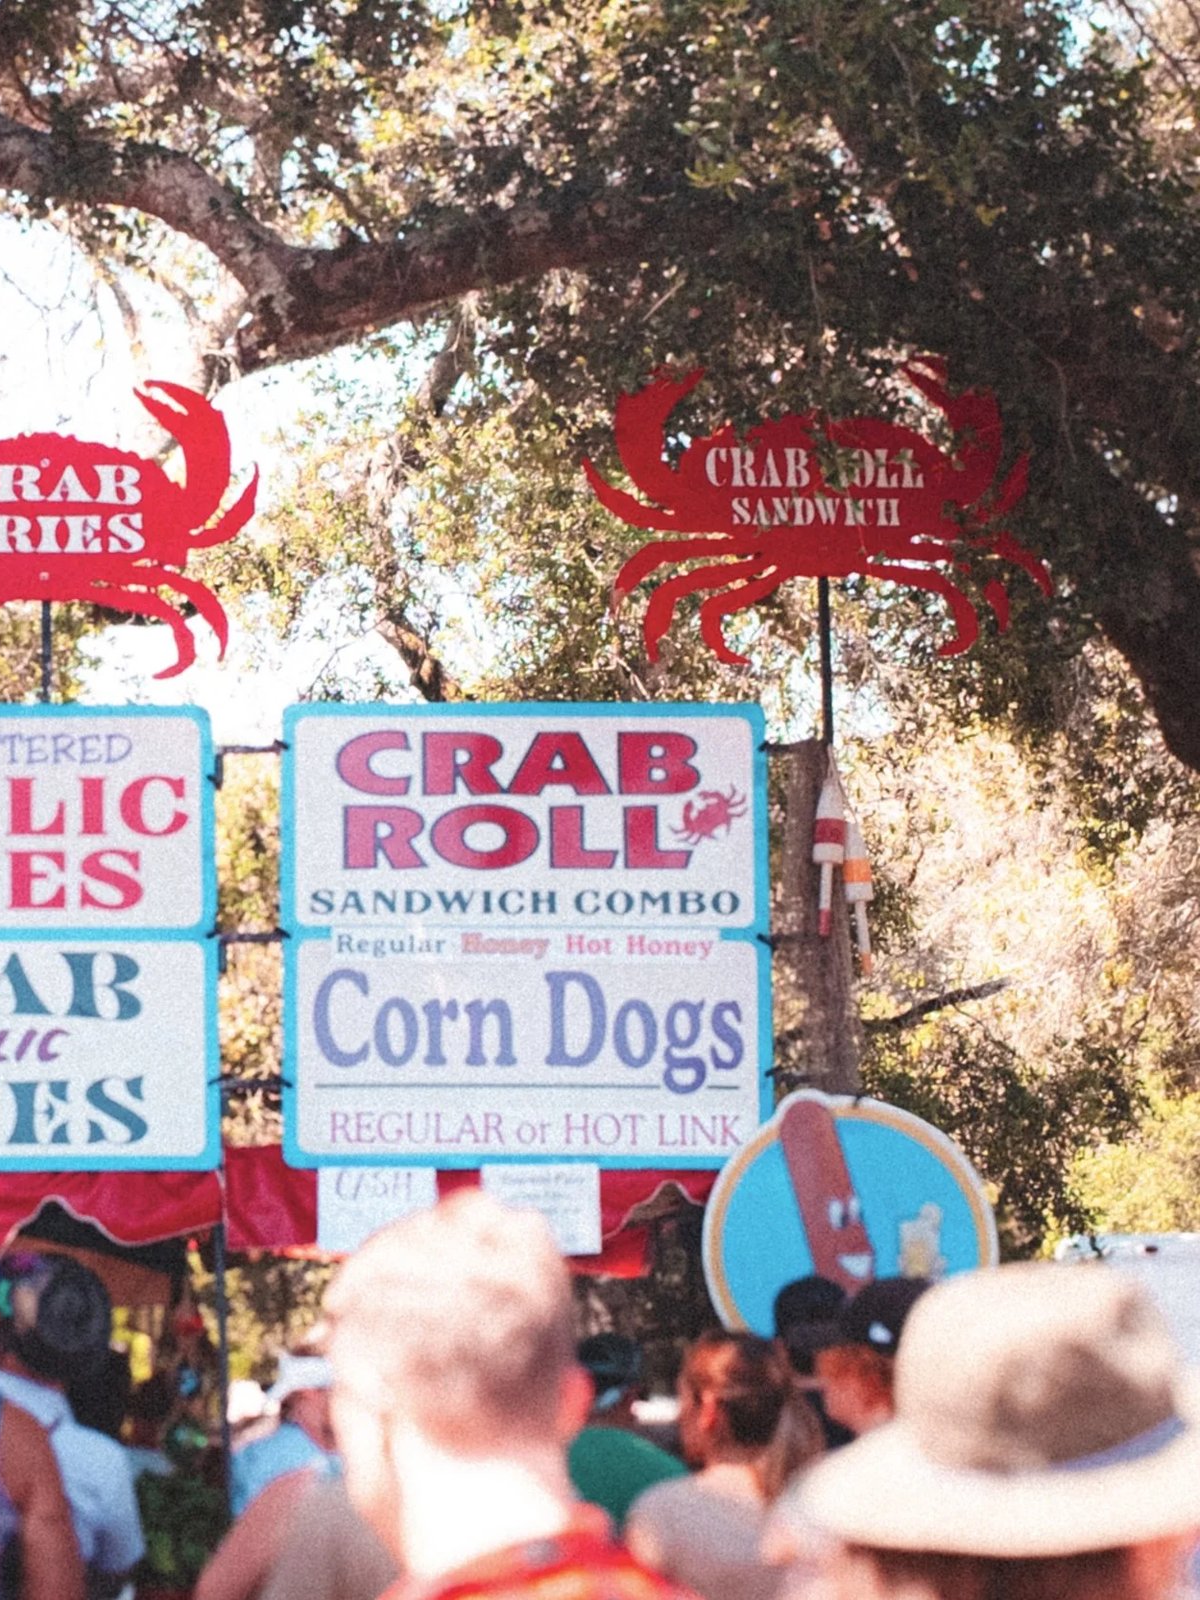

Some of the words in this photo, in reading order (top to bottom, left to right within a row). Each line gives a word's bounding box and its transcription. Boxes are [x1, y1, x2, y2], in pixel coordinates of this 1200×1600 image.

[705, 447, 810, 487] CRAB
[731, 496, 900, 526] SANDWICH
[336, 730, 701, 796] CRAB
[343, 803, 694, 870] ROLL
[309, 889, 557, 915] SANDWICH
[574, 889, 740, 915] COMBO
[336, 934, 446, 958] Regular
[460, 932, 550, 960] Honey
[566, 934, 612, 955] Hot
[626, 935, 714, 959] Honey
[313, 969, 517, 1067] Corn
[544, 970, 744, 1094] Dogs
[329, 1111, 503, 1145] REGULAR
[517, 1120, 553, 1145] or
[564, 1114, 645, 1146] HOT
[658, 1114, 743, 1148] LINK
